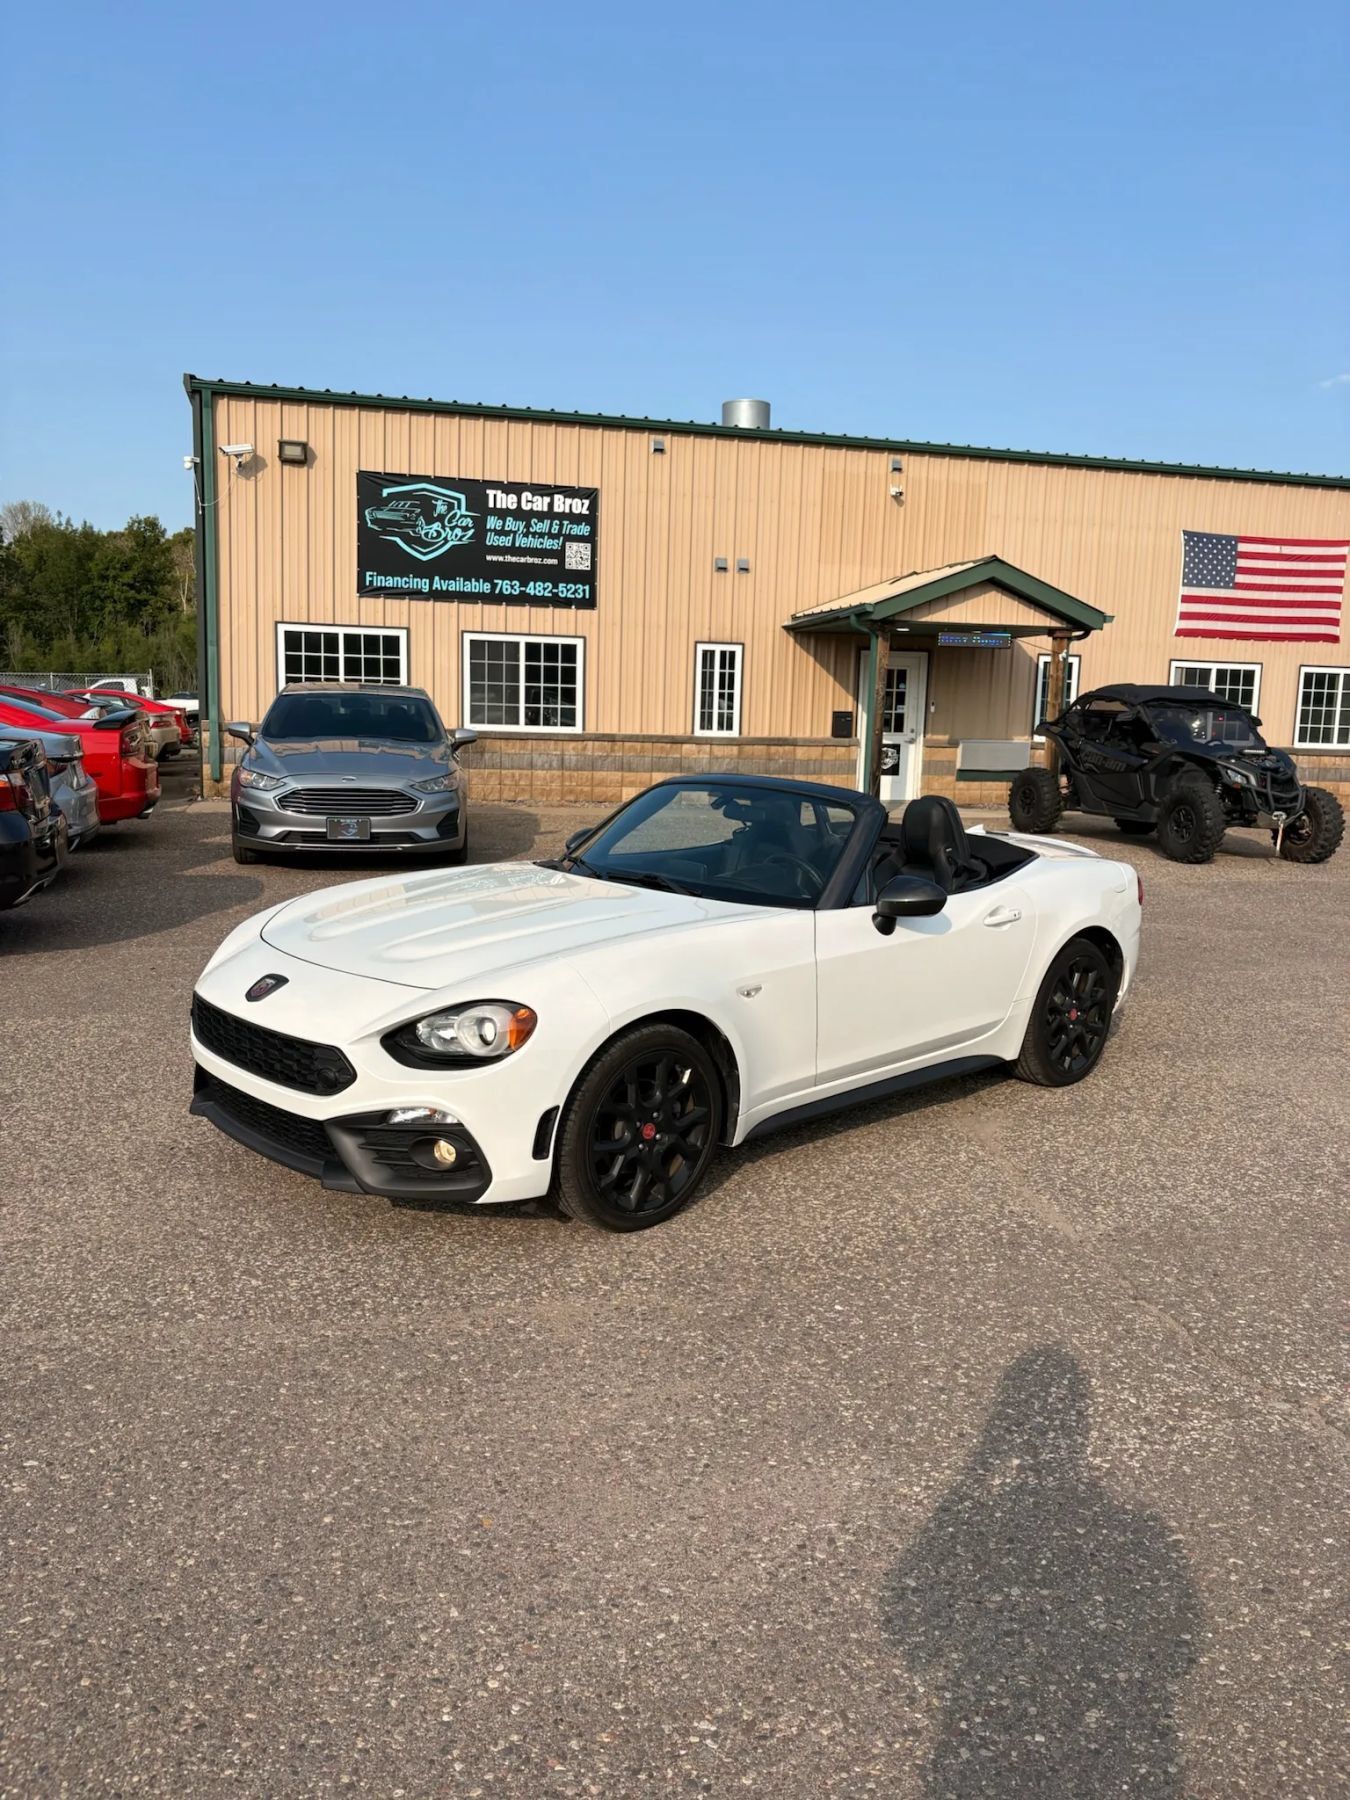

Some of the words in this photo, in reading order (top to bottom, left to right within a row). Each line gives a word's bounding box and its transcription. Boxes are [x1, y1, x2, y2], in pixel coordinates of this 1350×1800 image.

[486, 489, 518, 510] The
[521, 491, 551, 512] Car
[553, 494, 590, 515] Broz
[444, 509, 474, 528] Car
[486, 515, 503, 531] We
[504, 516, 527, 534] Buy,
[529, 518, 550, 534] Sell
[551, 520, 560, 534] &
[562, 521, 591, 536] Trade
[421, 521, 475, 542] Broz
[485, 532, 513, 547] Used
[514, 534, 563, 550] Vehicles!
[486, 554, 559, 566] www.thecarbroz.com
[365, 571, 430, 593] Financing
[432, 575, 492, 594] Available
[493, 579, 590, 599] 763-482-5231
